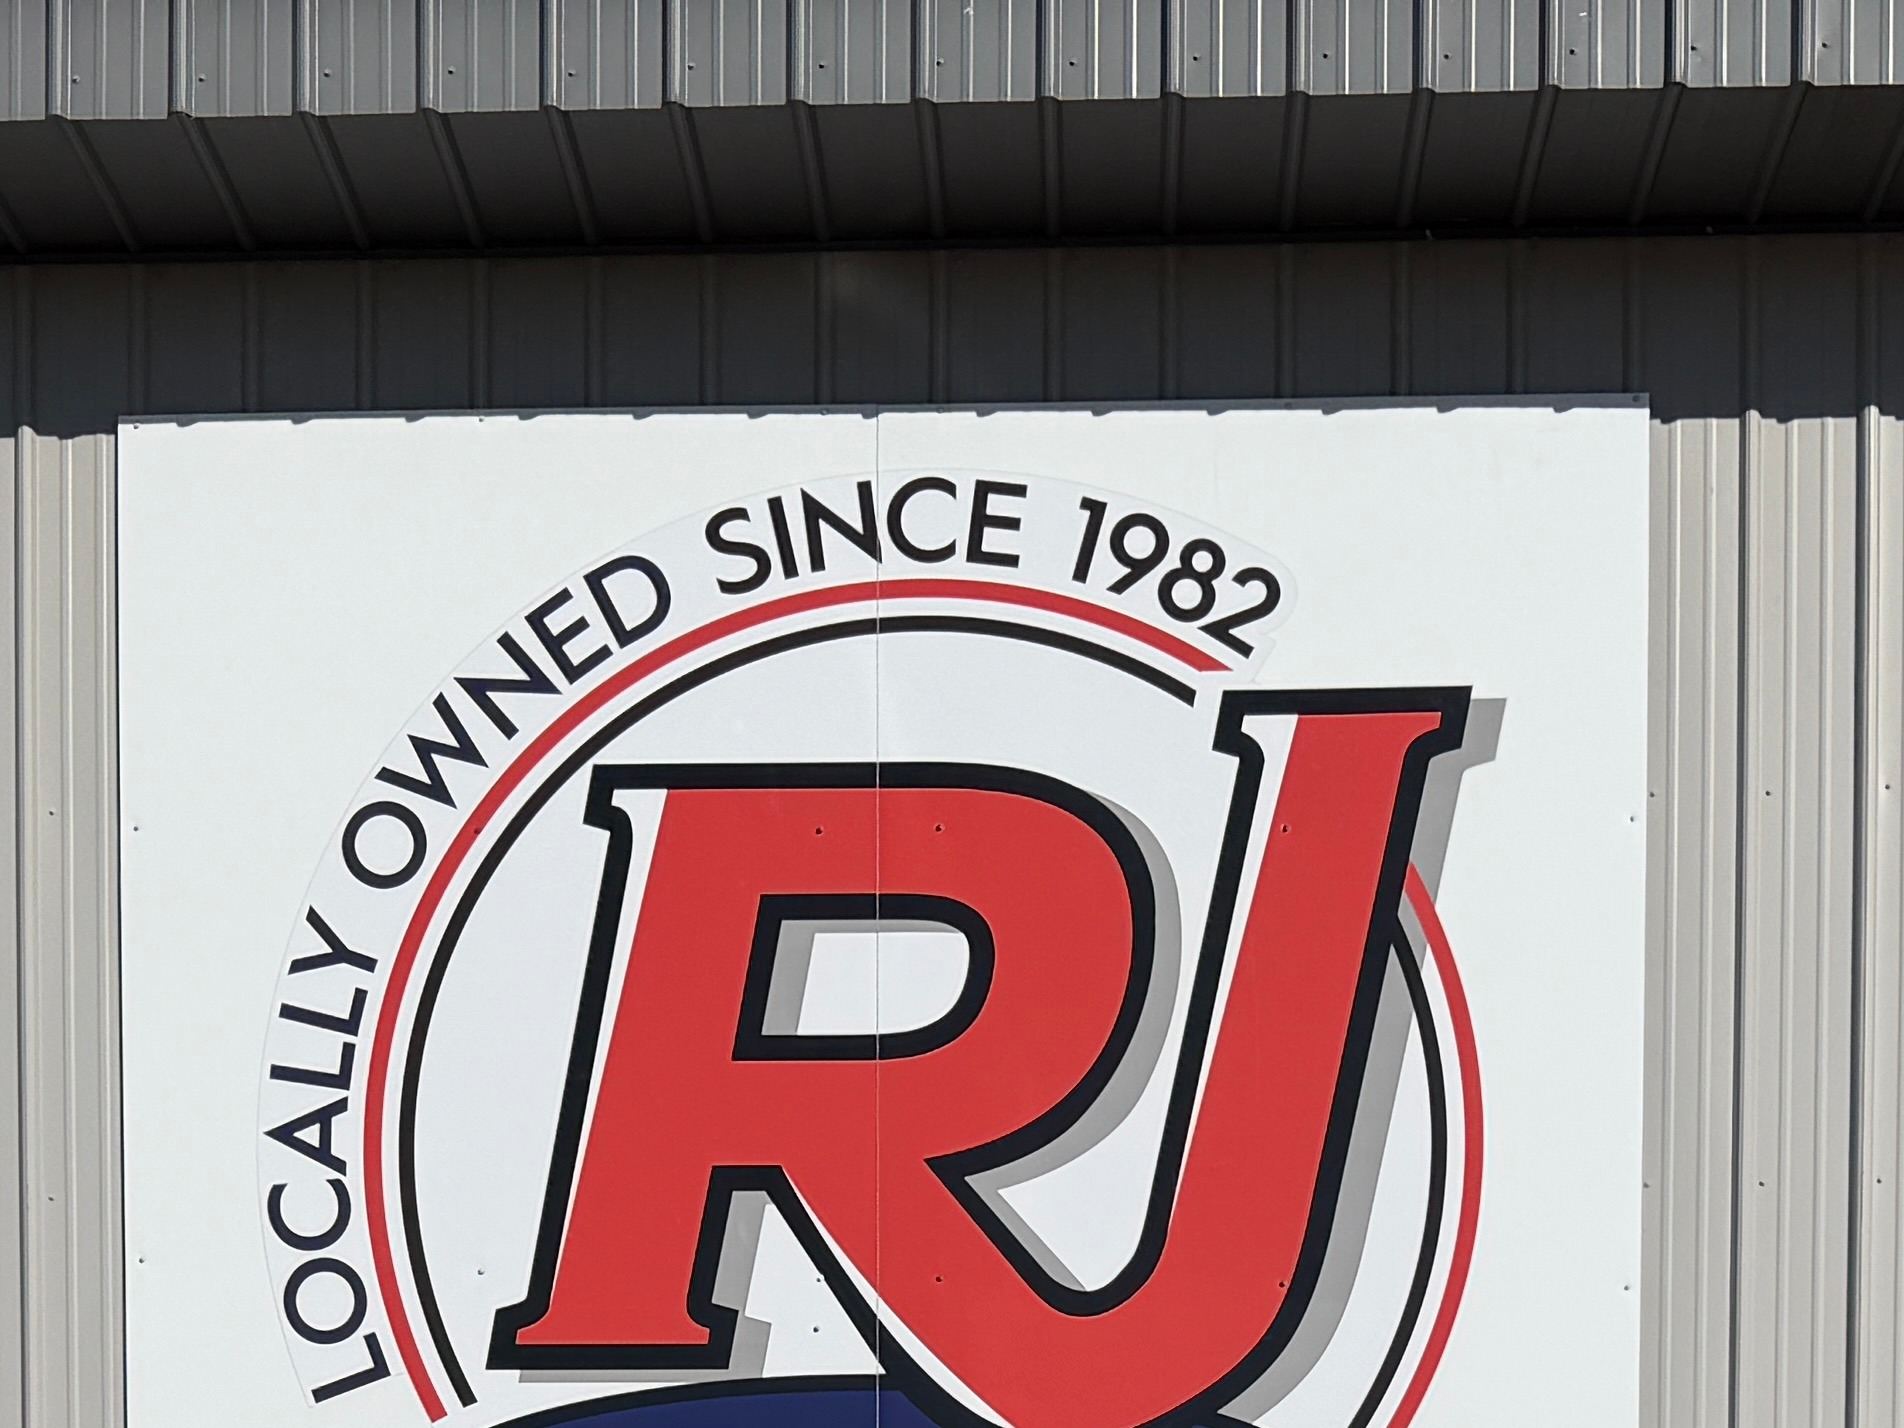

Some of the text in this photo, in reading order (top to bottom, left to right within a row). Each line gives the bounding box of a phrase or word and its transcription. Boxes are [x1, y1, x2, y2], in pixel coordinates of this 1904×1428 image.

[264, 476, 1281, 1404] LOCALLY OWNED SINCE 1982
